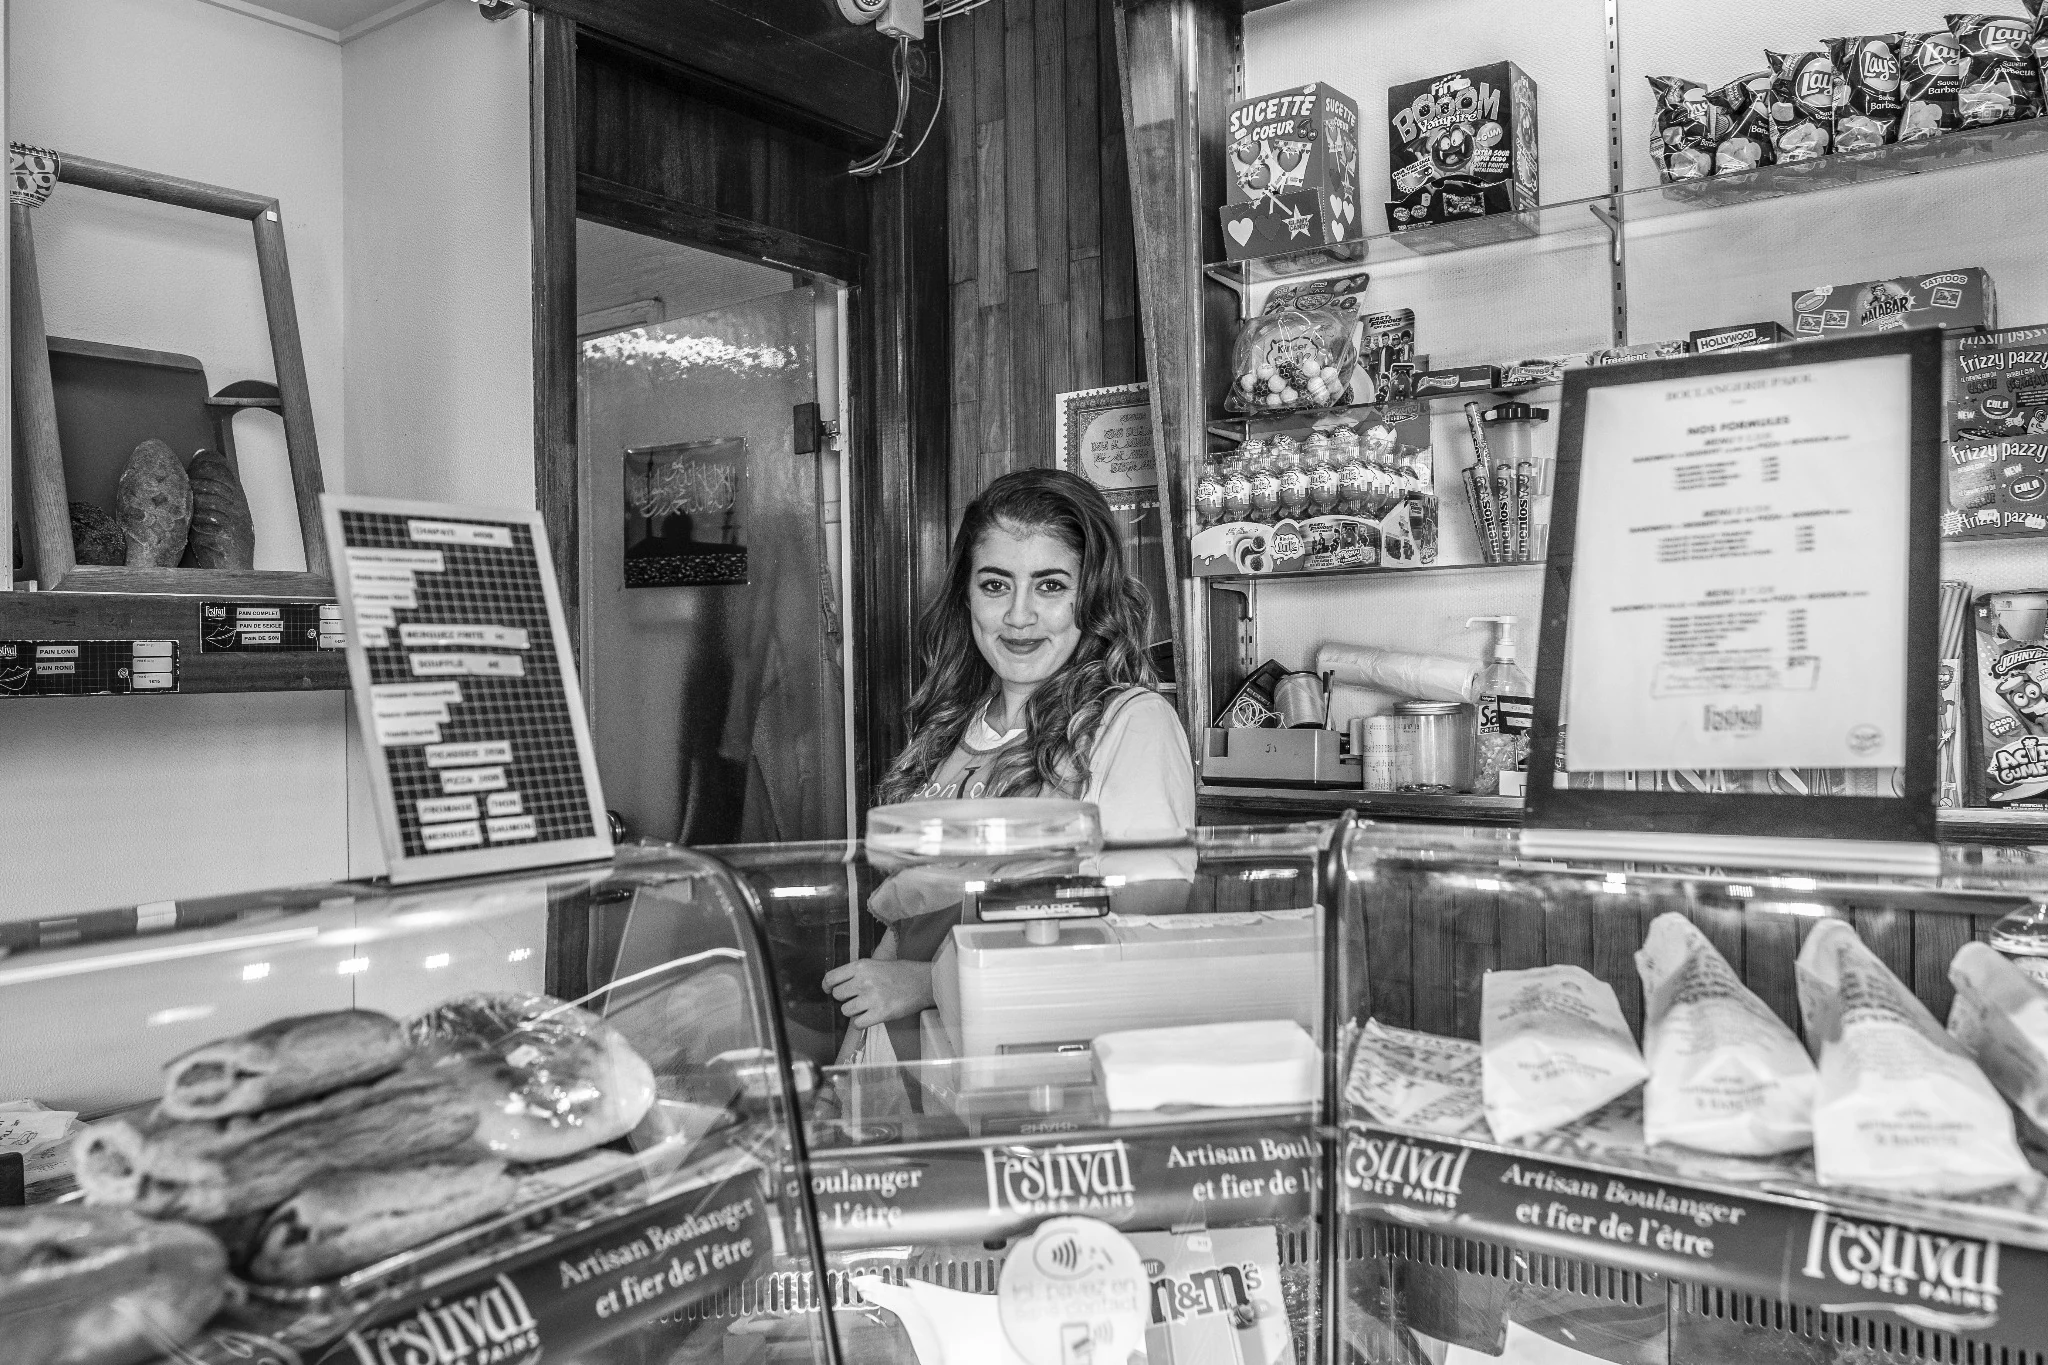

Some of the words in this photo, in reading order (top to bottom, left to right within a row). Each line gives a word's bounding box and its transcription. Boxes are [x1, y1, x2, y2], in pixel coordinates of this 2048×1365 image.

[1864, 51, 1897, 81] Lay's
[1230, 95, 1316, 133] SUCETTE
[1325, 97, 1356, 127] SUCETTE
[1417, 110, 1478, 132] Vampire
[1252, 119, 1294, 141] COEUR
[1921, 274, 1968, 289] TATTOOS
[1861, 296, 1910, 326] MALABAR
[1700, 330, 1754, 350] HOLLYWOOD
[1602, 352, 1649, 365] Freedent
[1959, 352, 2005, 374] frizzy
[2008, 351, 2048, 370] pazzy
[1957, 410, 1976, 420] NEW
[1986, 399, 2009, 409] COLA
[1950, 443, 1998, 465] frizzy
[2001, 442, 2048, 463] pazzy
[2003, 462, 2023, 478] NEW
[2013, 479, 2040, 494] COLA
[1482, 500, 1500, 557] mentos
[1499, 501, 1512, 556] mentos
[1518, 499, 1529, 556] mentos
[1998, 650, 2036, 672] JOHNY
[1989, 717, 2013, 730] GOOD
[1167, 1143, 1257, 1169] Artisan
[981, 1138, 1136, 1216] Festival
[1192, 1178, 1216, 1201] et
[1221, 1172, 1266, 1199] fier
[1268, 1168, 1299, 1196] de
[1078, 1191, 1135, 1211] PAINS
[1362, 1176, 1397, 1197] DES
[1401, 1184, 1458, 1209] PAINS
[1500, 1162, 1599, 1200] Artisan
[1603, 1180, 1747, 1229] Boulanger
[558, 1237, 648, 1290] Artisan
[645, 1198, 756, 1258] Boulanger
[1515, 1200, 1544, 1225] et
[1544, 1200, 1597, 1238] fier
[1597, 1211, 1636, 1244] de
[1636, 1214, 1715, 1259] l'être
[1801, 1211, 2004, 1297] Festival
[595, 1293, 618, 1318] et
[619, 1271, 666, 1310] fier
[667, 1256, 696, 1289] de
[694, 1236, 754, 1281] l'être
[1860, 1270, 1909, 1296] DES
[1918, 1279, 1999, 1313] PAINS
